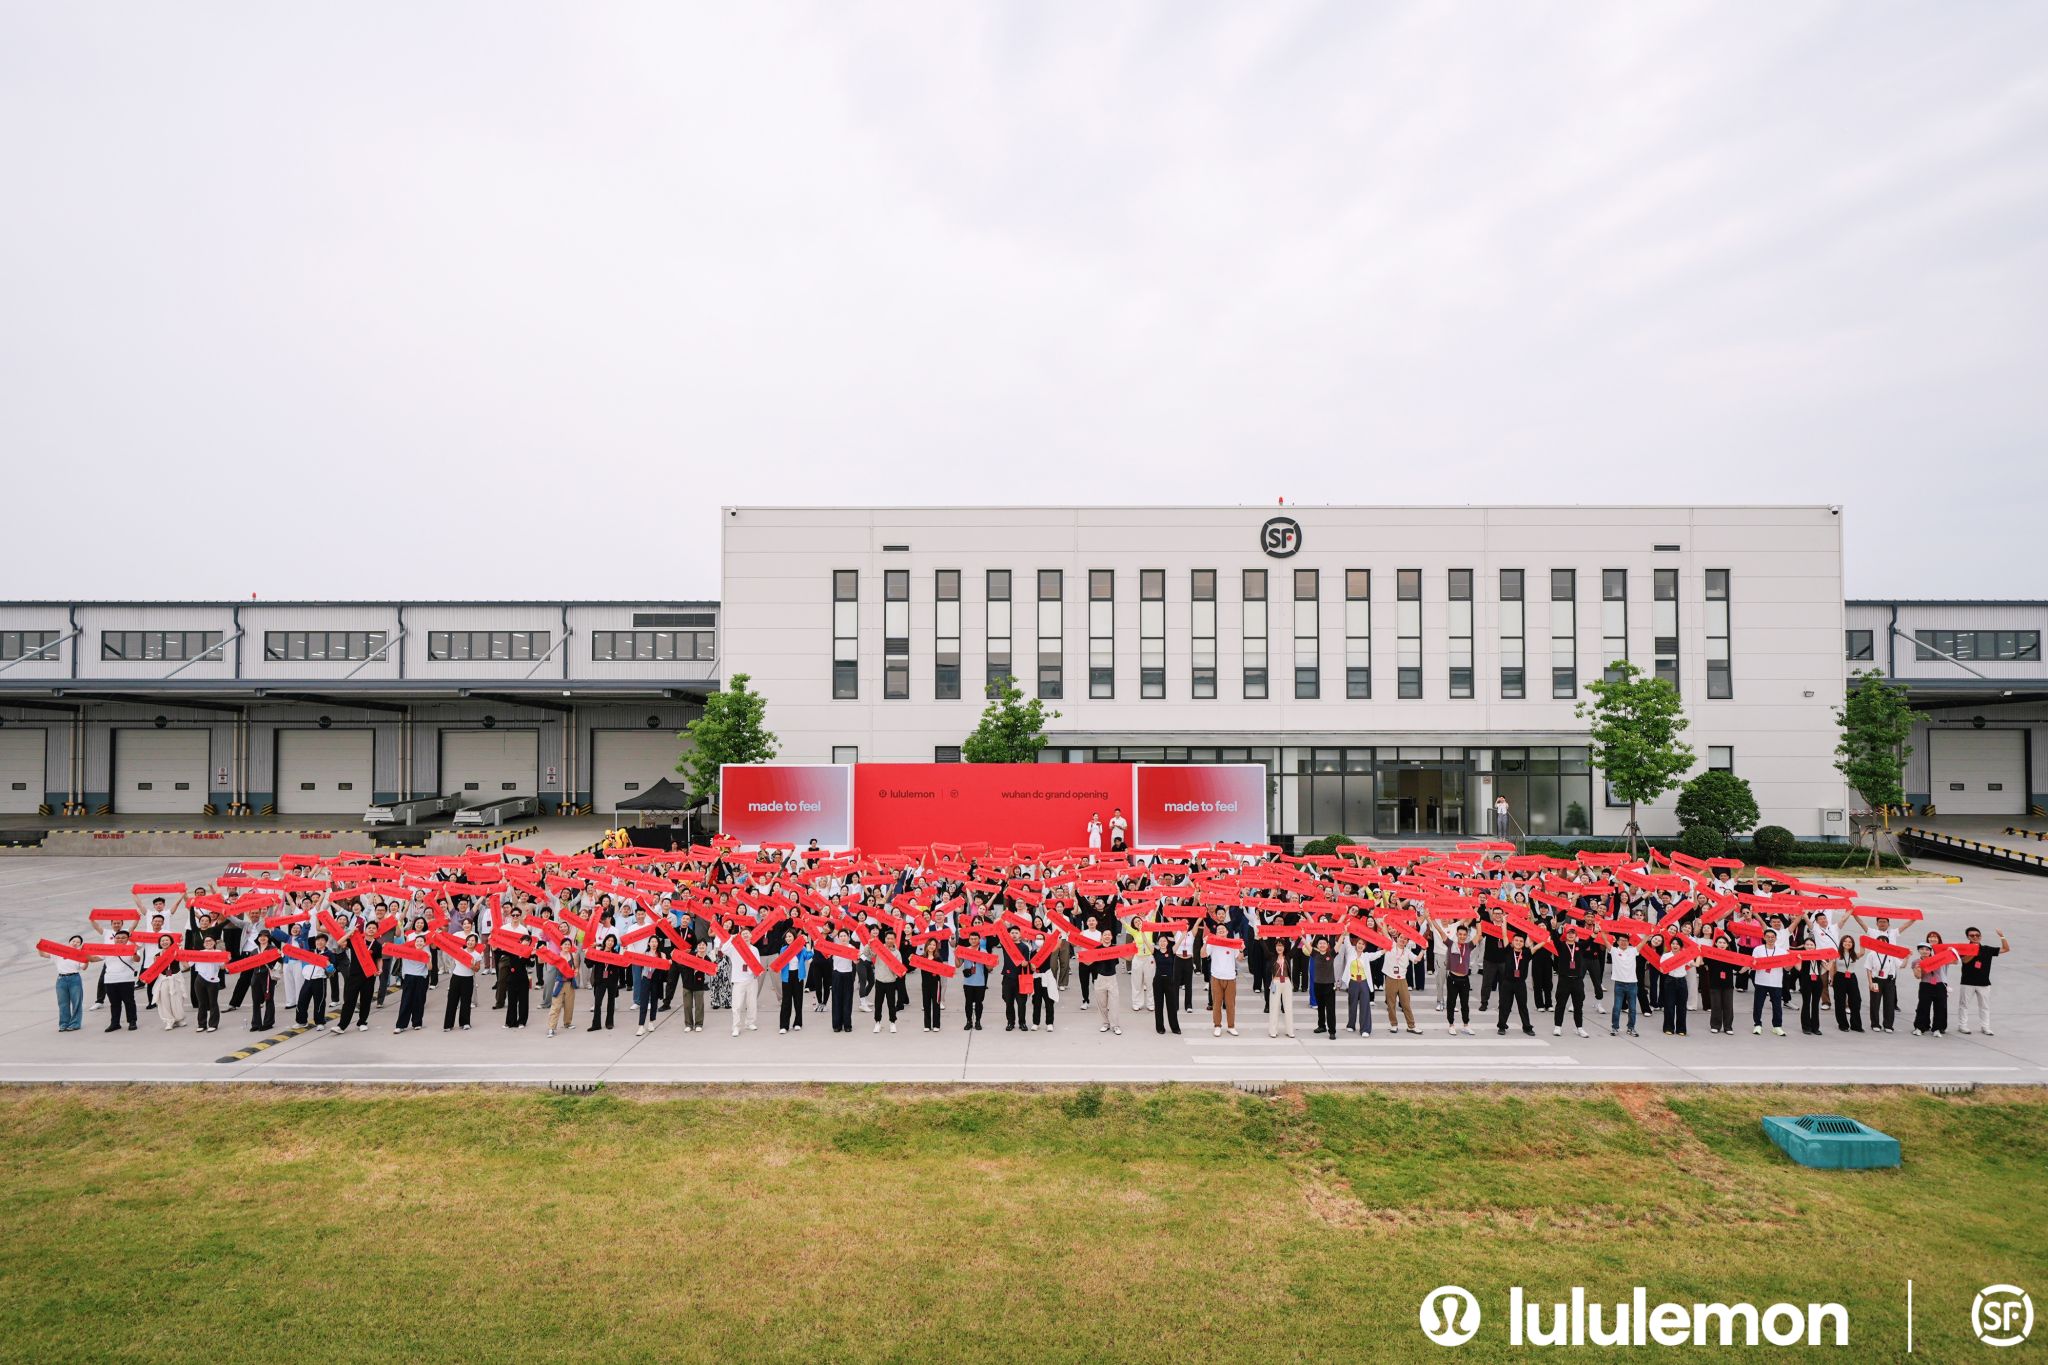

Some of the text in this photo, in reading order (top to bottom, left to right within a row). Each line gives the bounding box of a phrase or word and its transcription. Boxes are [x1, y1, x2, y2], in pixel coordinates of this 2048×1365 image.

[890, 789, 935, 798] lululemon
[1001, 790, 1109, 801] wuhan dc grand opening
[748, 800, 821, 812] made to feel
[1164, 800, 1238, 812] made to feel
